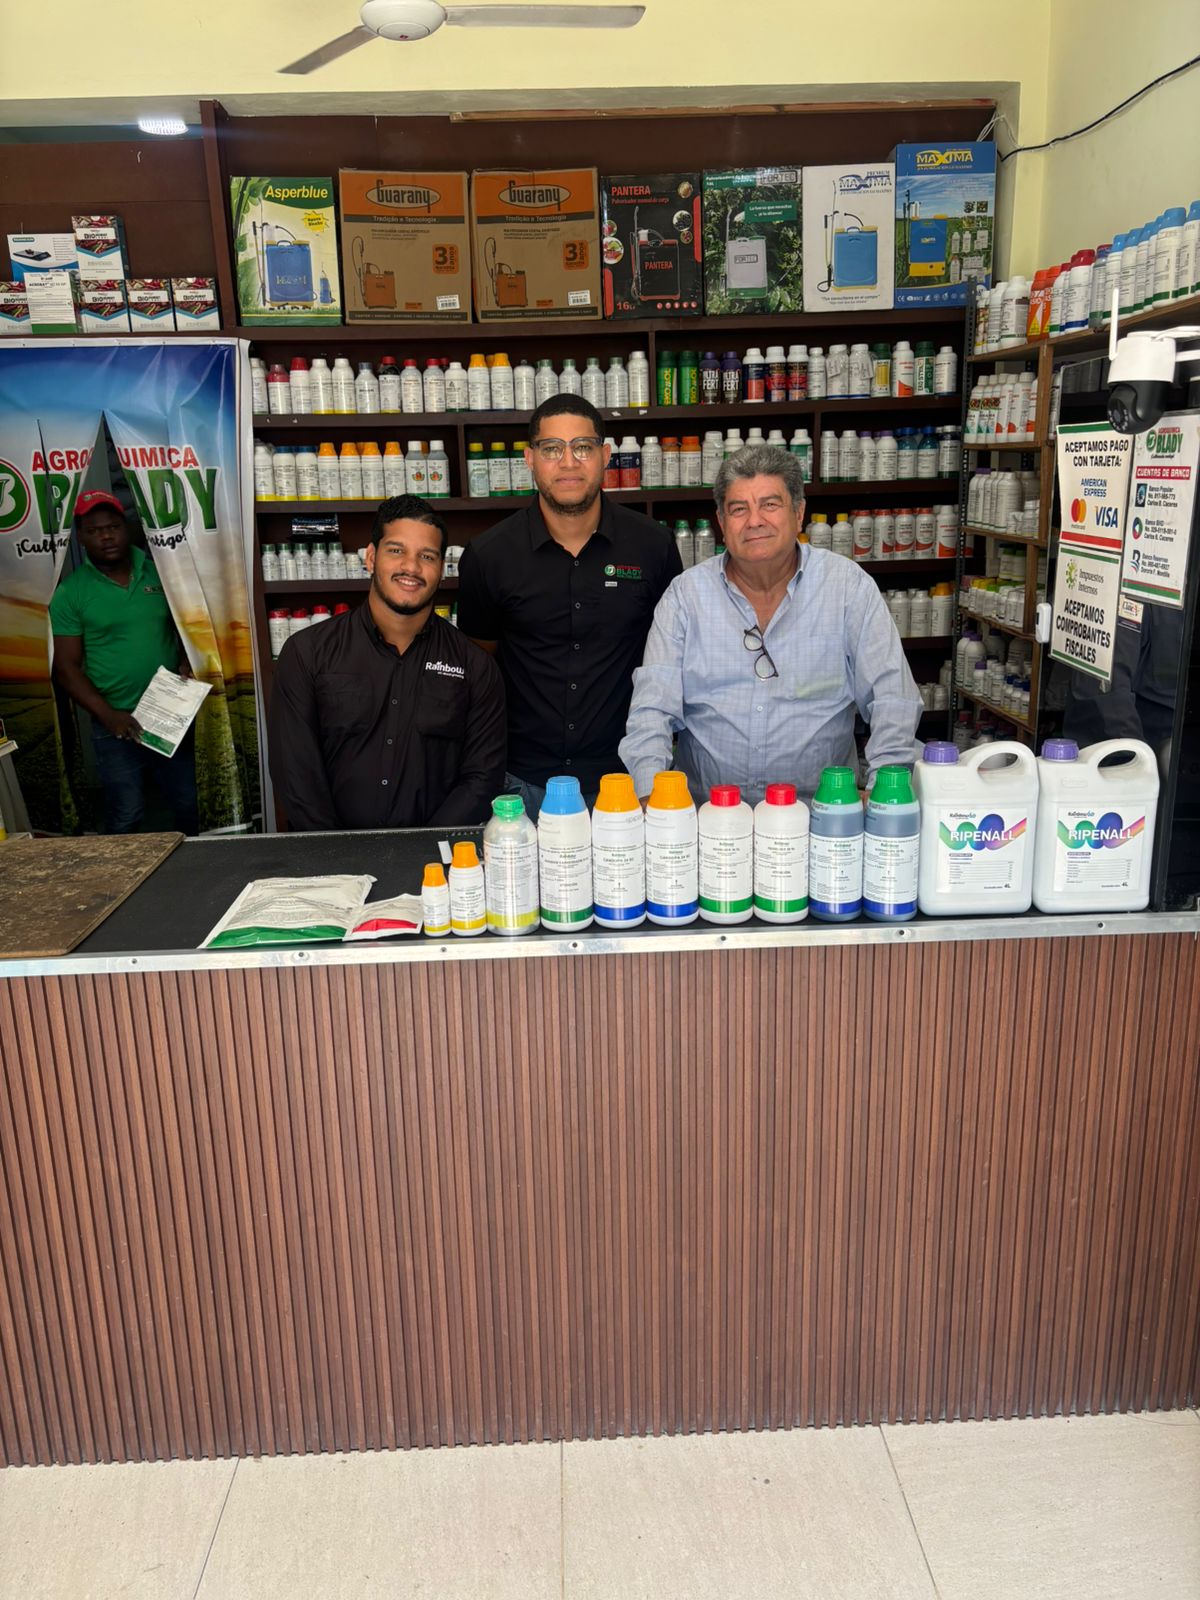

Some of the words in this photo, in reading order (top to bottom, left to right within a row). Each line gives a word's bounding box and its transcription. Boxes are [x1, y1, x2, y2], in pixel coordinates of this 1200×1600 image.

[916, 150, 973, 166] MAXIMA
[265, 185, 328, 201] Asperblue
[376, 179, 431, 213] Guarany
[508, 180, 560, 212] Guarany
[611, 186, 651, 197] PANTERA
[435, 246, 448, 265] 3
[565, 243, 577, 261] 3
[644, 261, 673, 270] PANTERA
[703, 370, 719, 379] ULTRA
[723, 371, 739, 380] ULTRA
[703, 379, 719, 390] FERT
[723, 380, 739, 391] FERT
[1065, 440, 1108, 453] ACEPTAMOS
[1109, 439, 1129, 452] PAGO
[1156, 433, 1184, 453] BLADY
[1073, 455, 1088, 467] CON
[1090, 455, 1122, 467] TARJETA:
[1137, 468, 1161, 477] CUENTAS
[1162, 469, 1170, 477] DE
[1170, 468, 1190, 478] BANCO
[1081, 478, 1107, 487] AMERICAN
[1083, 488, 1107, 497] EXPRESS
[1095, 506, 1118, 528] VISA
[617, 568, 641, 577] BLADY
[1079, 568, 1104, 584] Impuestos
[1078, 582, 1098, 596] Internos
[1064, 599, 1105, 625] ACEPTAMOS
[1056, 615, 1111, 649] COMPROBANTES
[1064, 638, 1097, 664] FISCALES
[425, 661, 464, 674] Rainbow
[950, 829, 1015, 842] RIPENALL
[1068, 827, 1133, 840] RIPENALL
